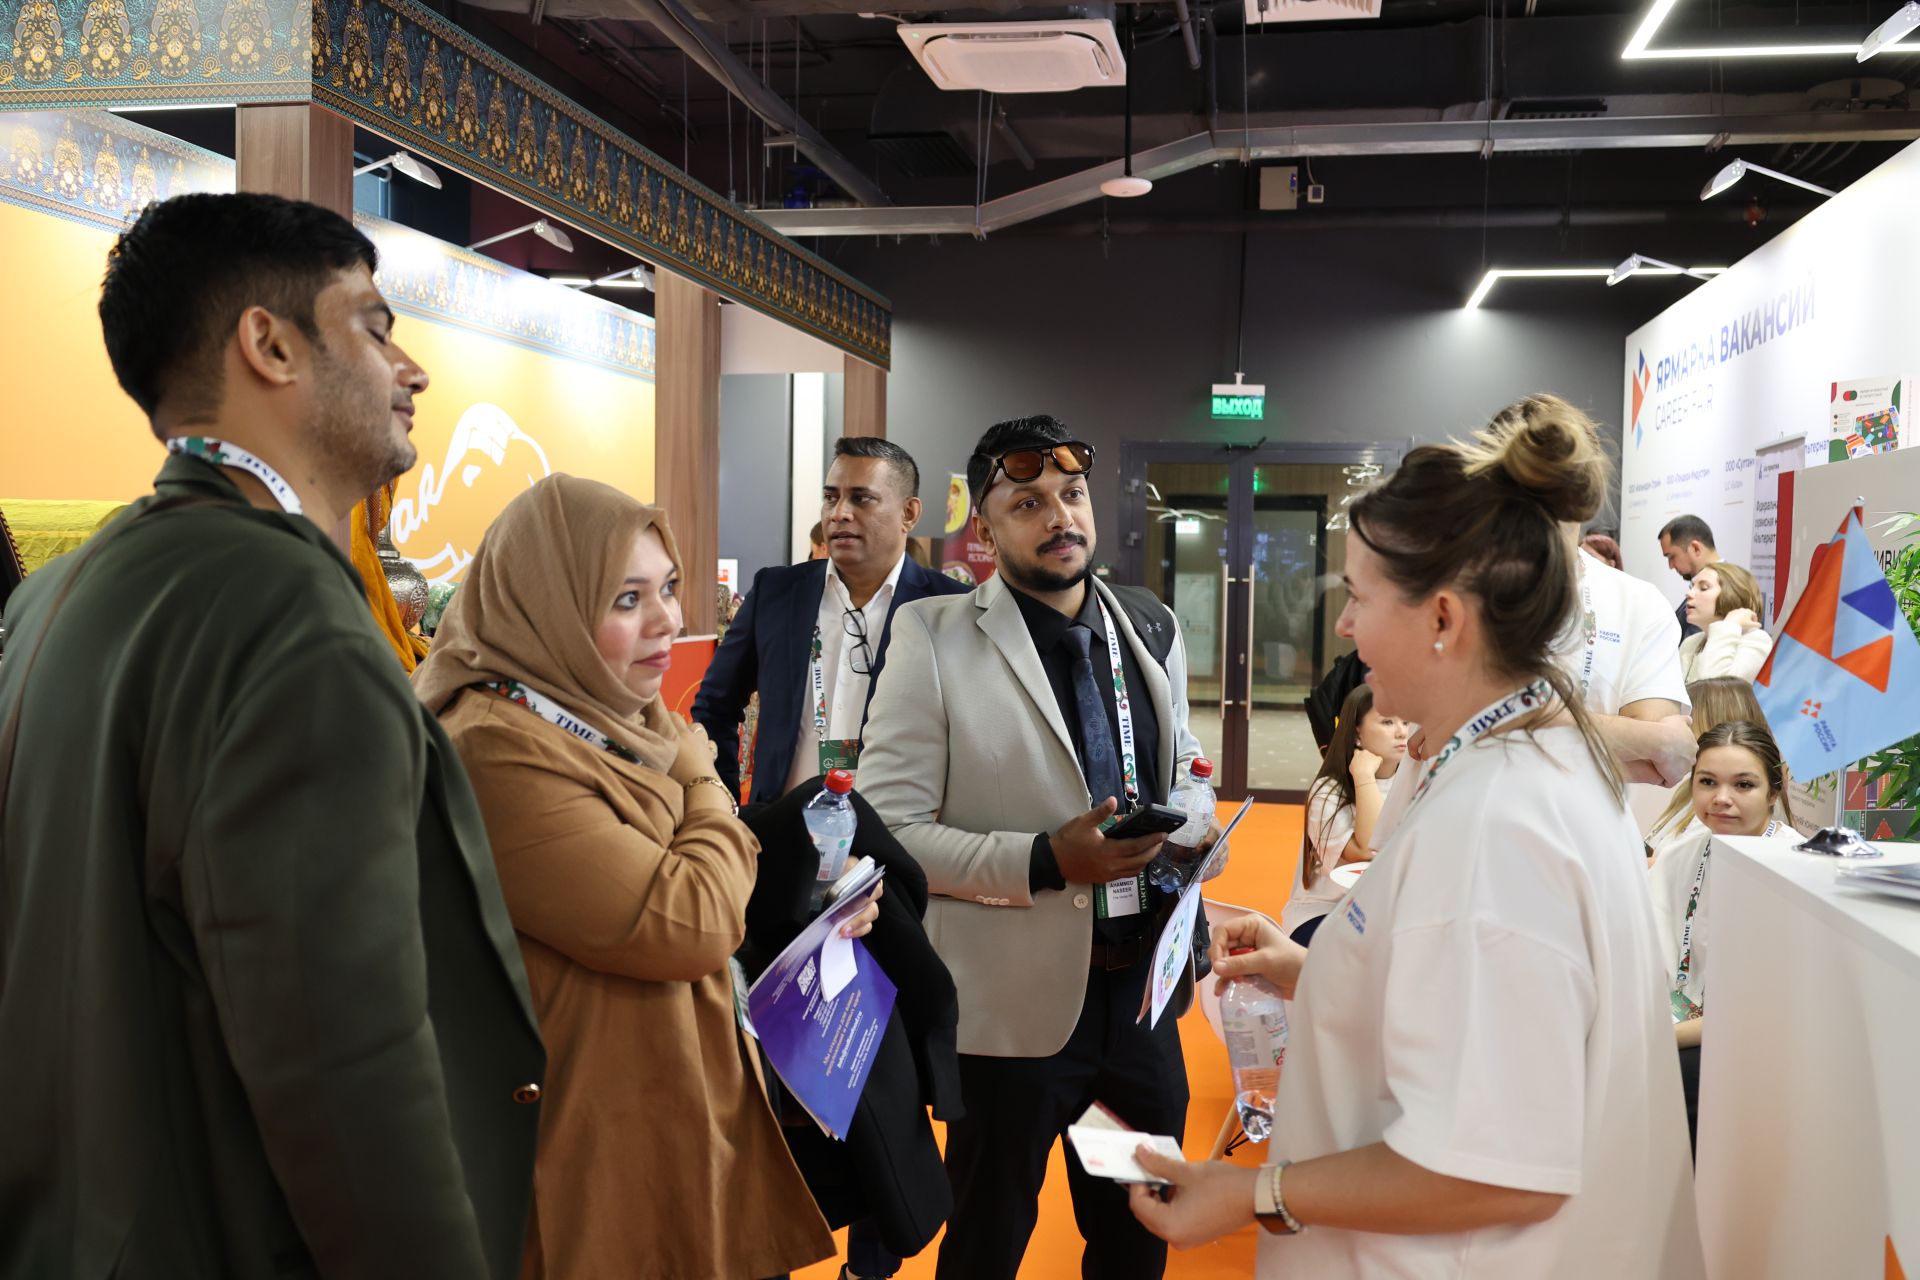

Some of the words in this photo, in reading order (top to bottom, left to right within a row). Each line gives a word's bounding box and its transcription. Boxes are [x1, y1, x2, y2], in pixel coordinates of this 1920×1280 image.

[1656, 334, 1715, 393] ЯРМАРКА
[1719, 268, 1816, 363] ВАКАНСИЙ
[1212, 397, 1263, 418] ВЫХОД
[1108, 631, 1119, 659] TIME
[1583, 649, 1593, 676] TIME
[815, 666, 823, 692] TIME
[555, 712, 596, 743] TIME
[1121, 715, 1132, 748] TIME
[1467, 700, 1516, 737] TIME
[1683, 924, 1691, 946] TIME
